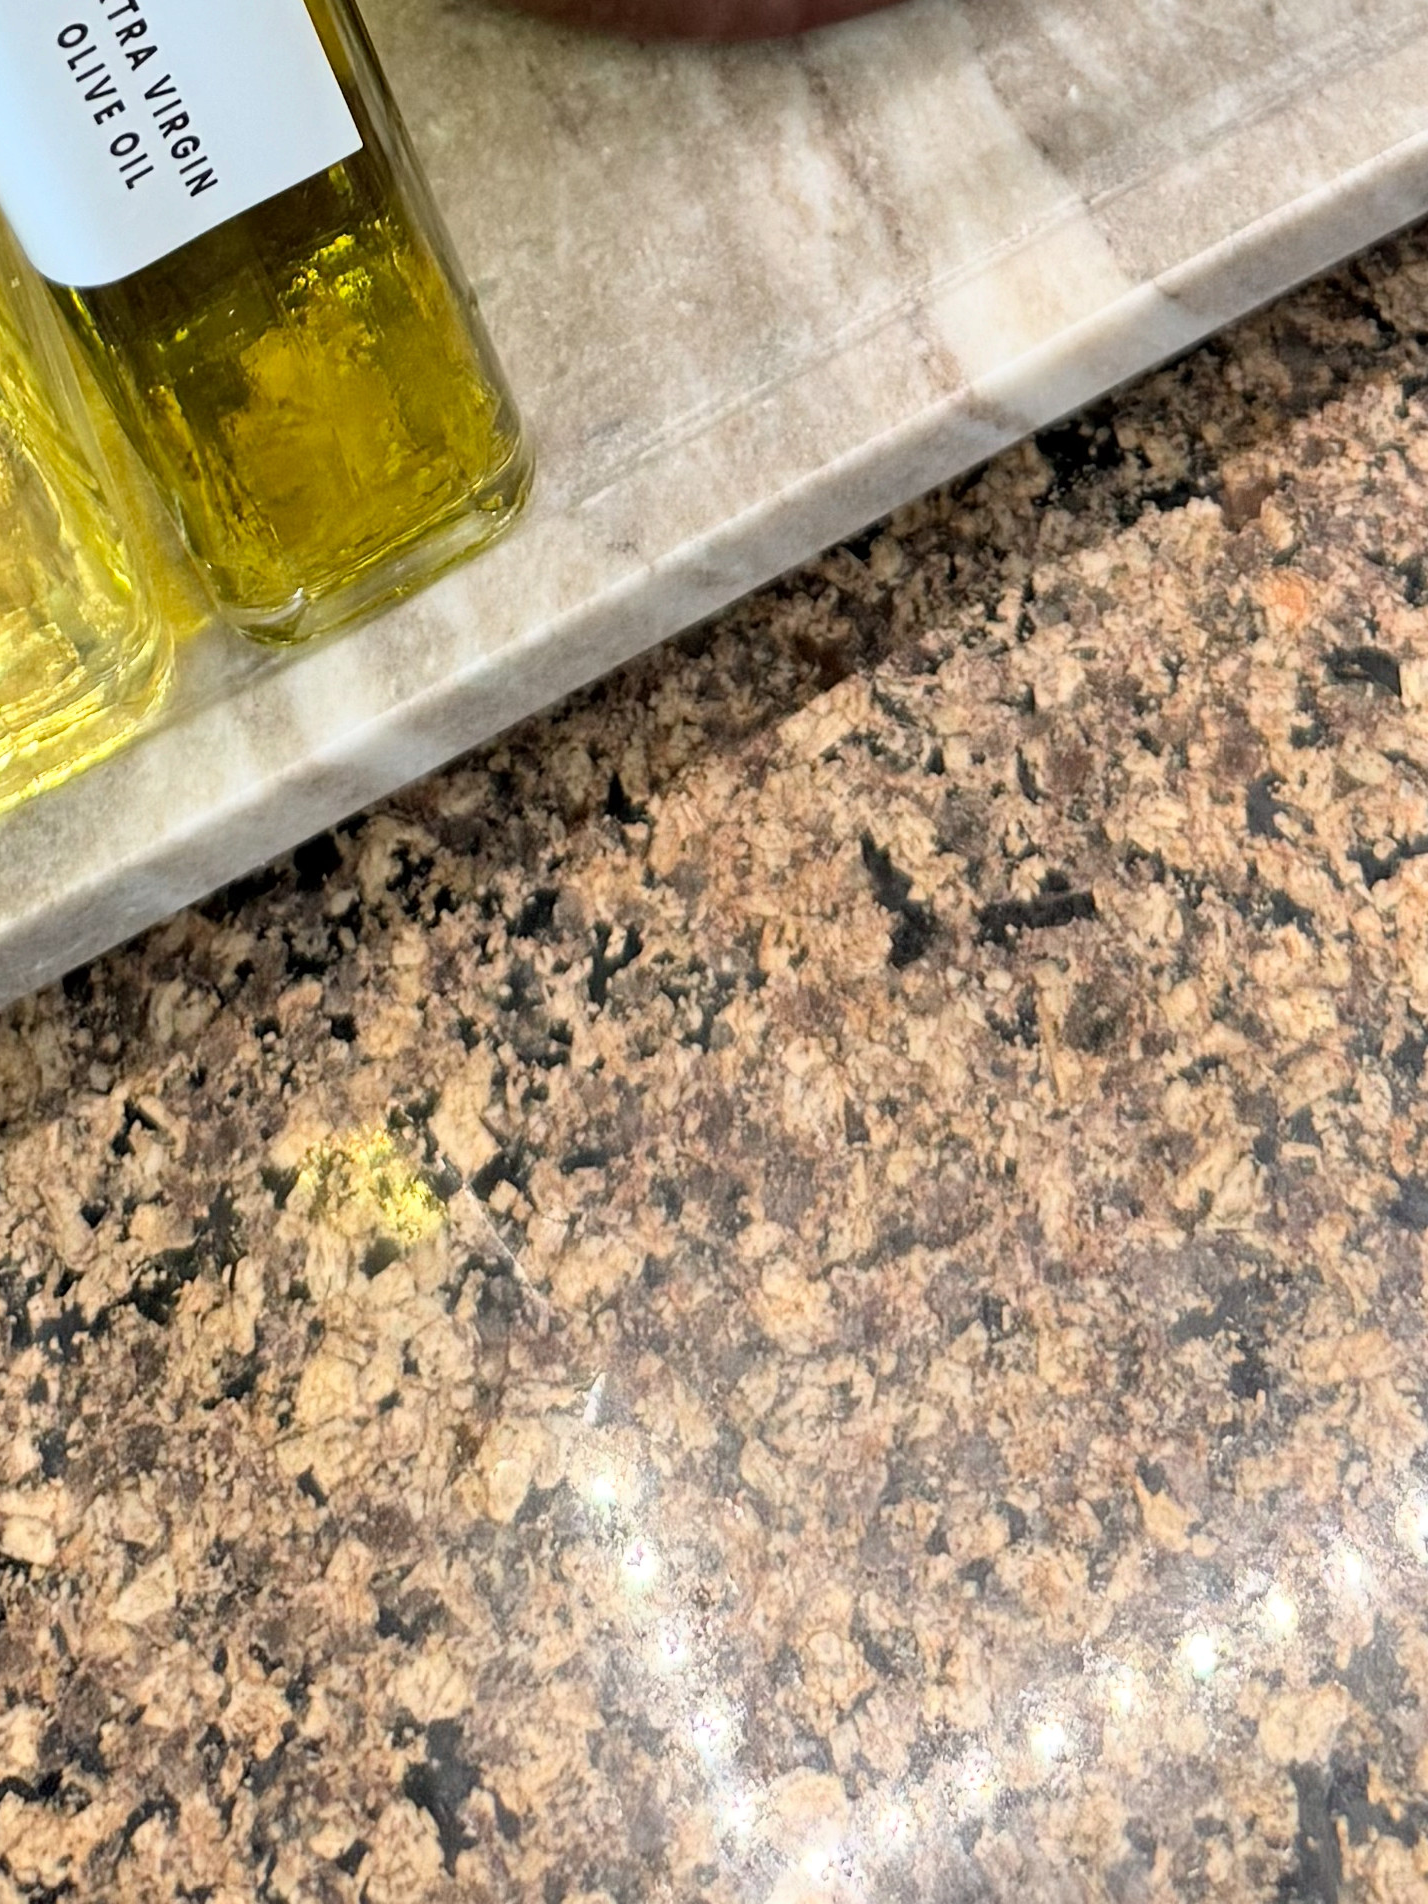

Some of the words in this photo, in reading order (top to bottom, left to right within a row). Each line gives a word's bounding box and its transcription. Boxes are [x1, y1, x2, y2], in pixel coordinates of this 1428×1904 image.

[56, 22, 127, 127] OLIVE
[108, 131, 155, 191] OIL
[143, 73, 219, 198] VIRGIN
